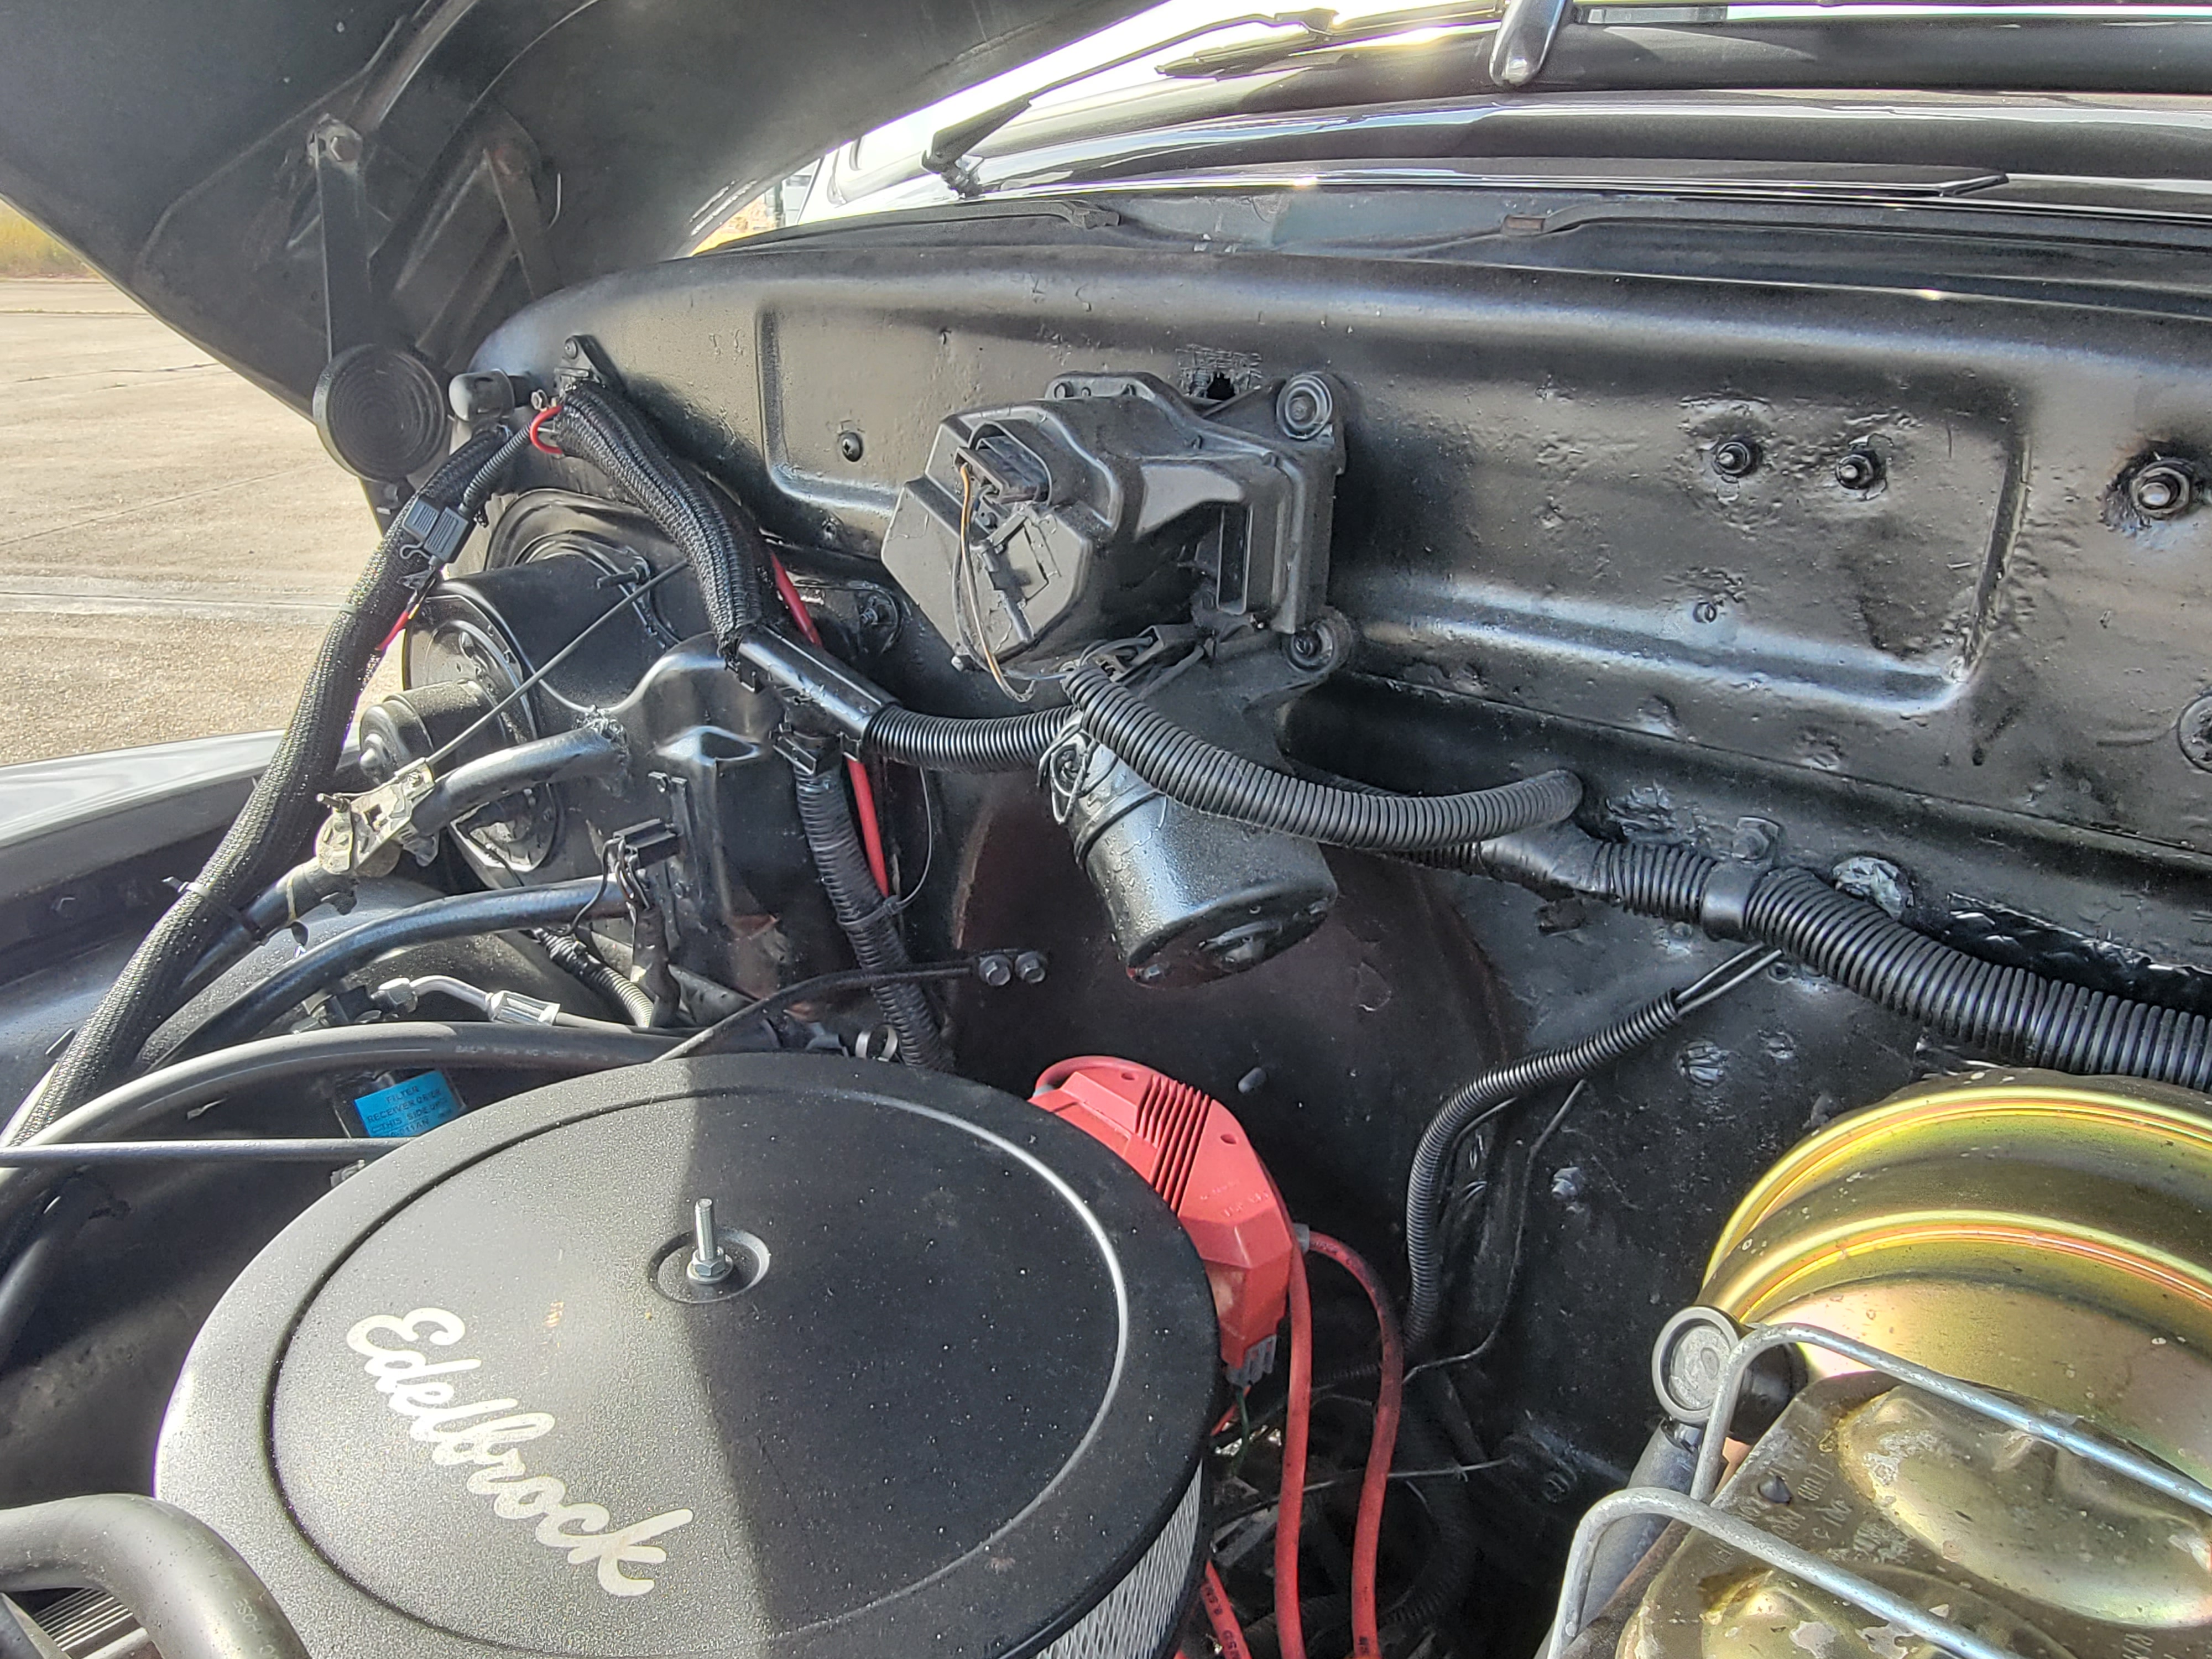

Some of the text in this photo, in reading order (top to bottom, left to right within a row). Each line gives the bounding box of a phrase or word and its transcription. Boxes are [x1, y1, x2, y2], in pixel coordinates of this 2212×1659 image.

[387, 1086, 420, 1104] FILTER
[367, 1099, 416, 1123] RECEIVER
[380, 1117, 403, 1131] THIS
[406, 1107, 429, 1121] SIDE
[346, 1307, 694, 1597] Edelbrock
